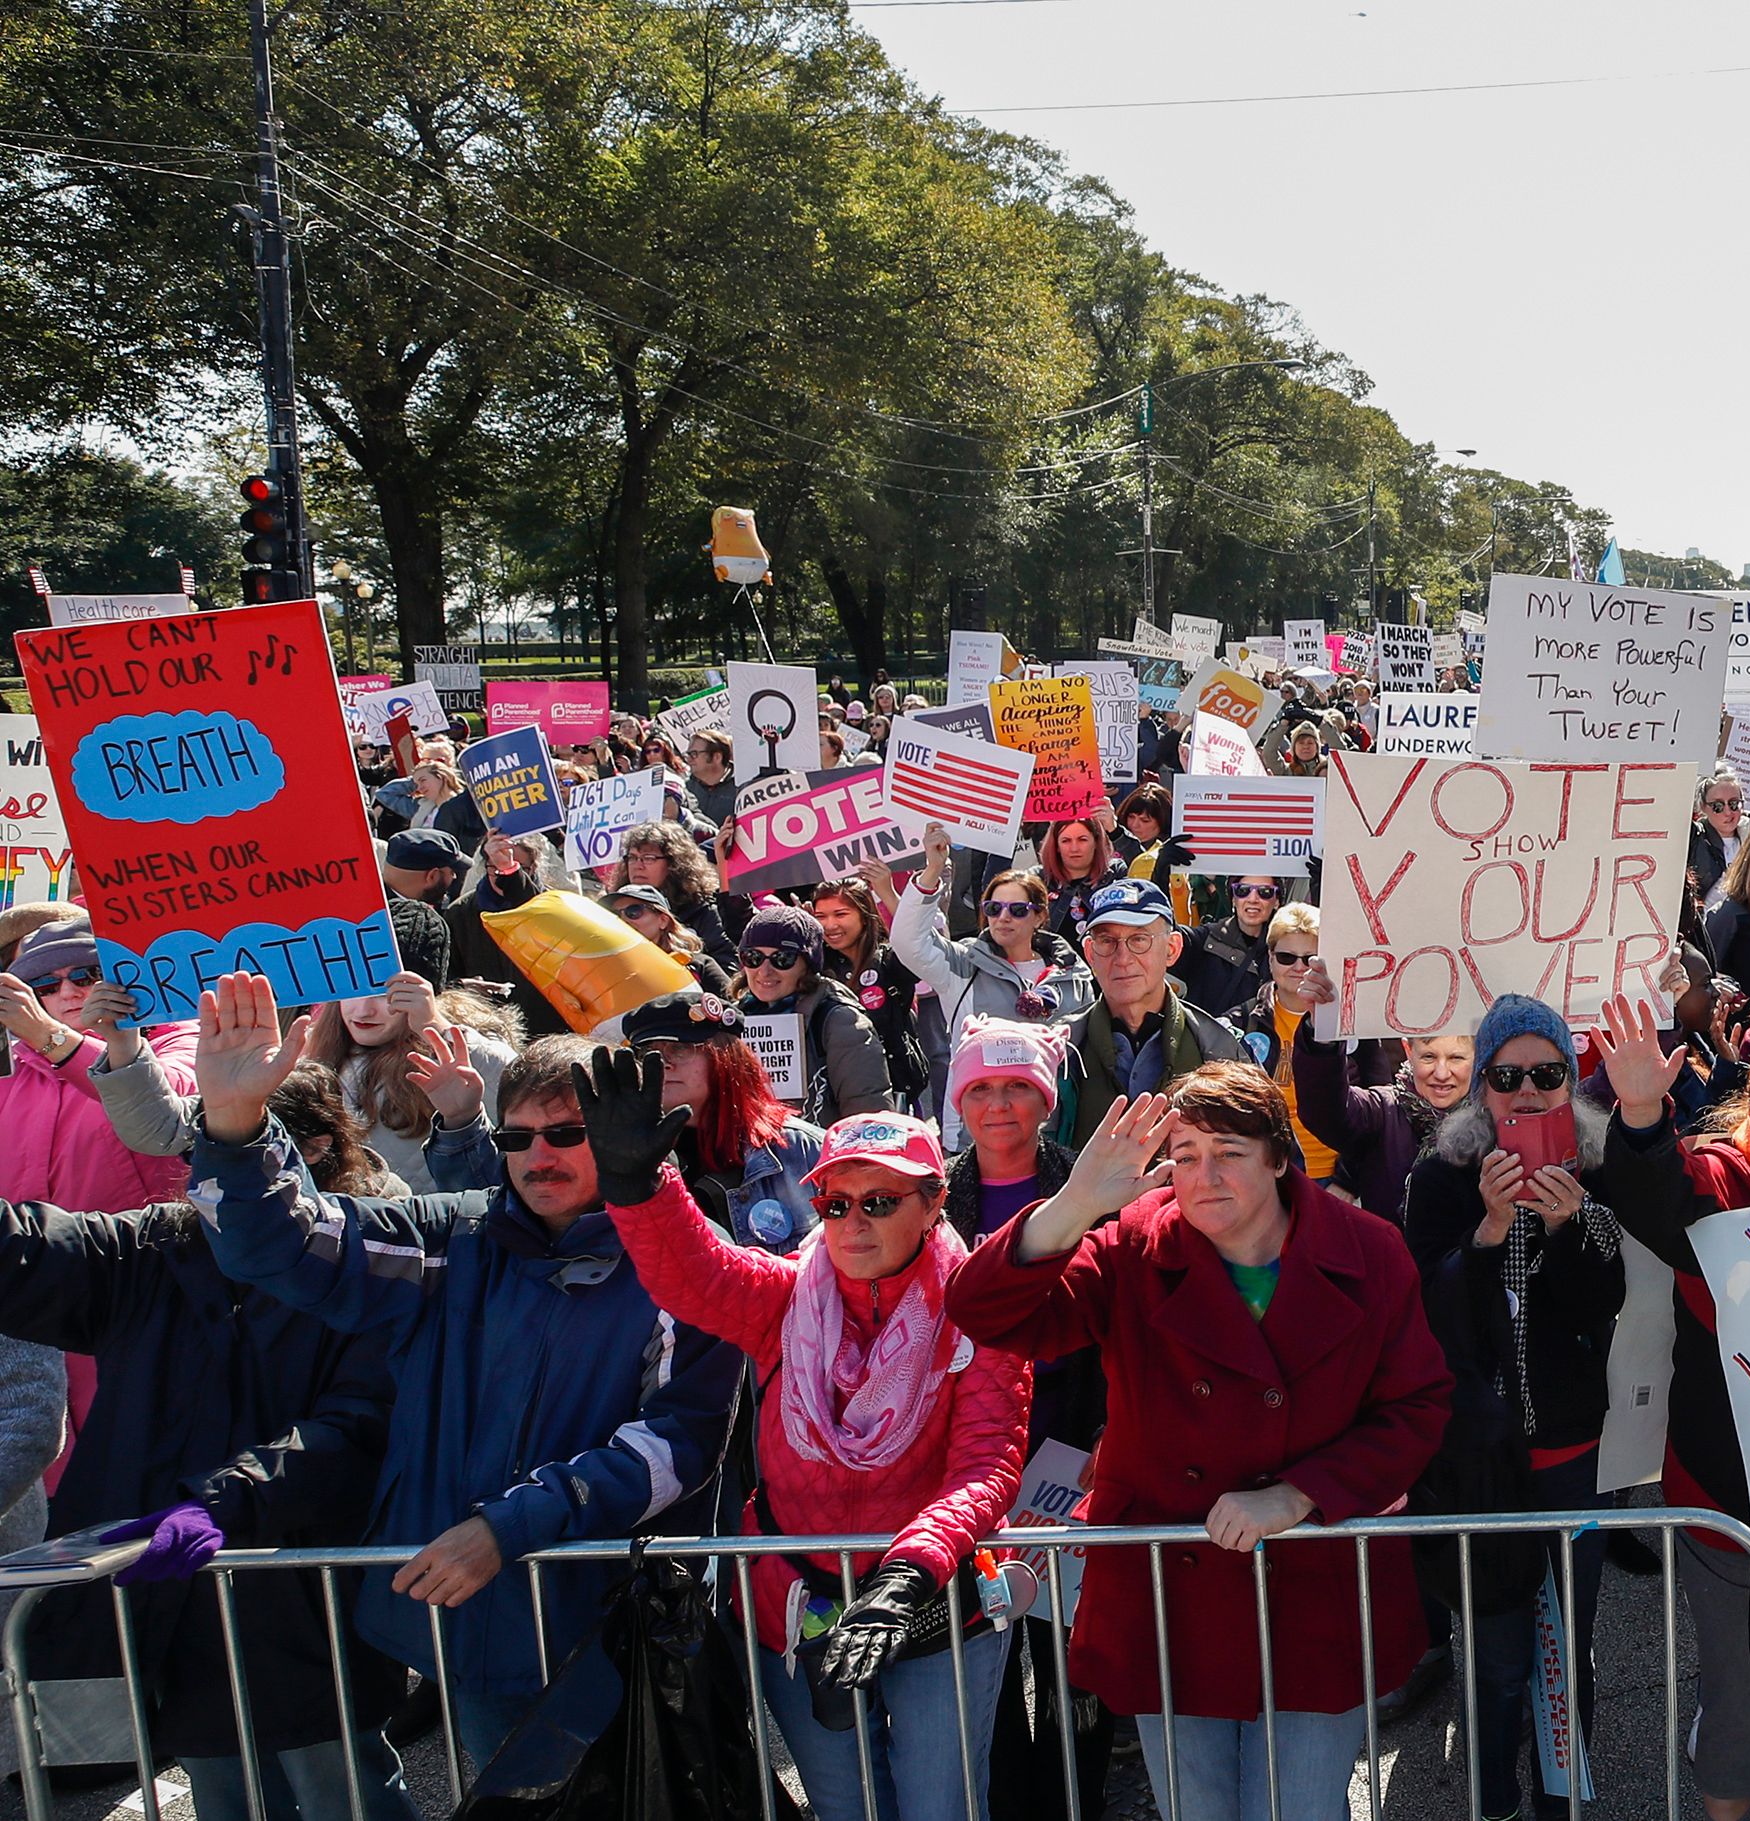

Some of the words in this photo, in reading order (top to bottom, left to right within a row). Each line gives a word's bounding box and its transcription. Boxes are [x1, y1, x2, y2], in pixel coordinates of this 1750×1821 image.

[1527, 592, 1572, 620] MY
[1589, 591, 1667, 626] VOTE
[1688, 606, 1716, 633] IS
[1173, 616, 1190, 633] We
[1191, 623, 1217, 637] march
[1346, 629, 1366, 643] 1920
[26, 630, 93, 667] WE
[127, 617, 218, 651] CAN'T
[1173, 638, 1189, 651] We
[1190, 640, 1209, 652] vote
[1292, 640, 1318, 650] WITH
[1342, 642, 1364, 655] 2018
[1534, 634, 1601, 661] MORE
[1154, 648, 1174, 658] Vote
[1296, 653, 1319, 662] HER
[1382, 644, 1401, 660] SO
[1402, 645, 1433, 662] THEY
[44, 660, 150, 708] HOLD
[159, 653, 223, 688] OUR
[424, 666, 475, 687] OUTTA
[997, 683, 1006, 697] I
[1019, 681, 1044, 694] AM
[1060, 676, 1085, 689] NO
[1011, 691, 1074, 707] LONGER
[1527, 673, 1594, 701] Than
[1612, 677, 1668, 709] Your
[564, 708, 604, 716] Parenthood
[1107, 699, 1138, 725] THE
[1146, 694, 1177, 710] 2018
[1200, 681, 1259, 727] fool
[946, 720, 962, 732] WE
[962, 717, 981, 728] ALL
[1000, 724, 1024, 735] THE
[1037, 715, 1080, 729] THINGS
[1032, 725, 1082, 739] CANNOT
[1548, 708, 1681, 746] TWEET!
[101, 723, 259, 800] BREATH
[895, 740, 933, 767] VOTE
[1046, 752, 1071, 763] AM
[1740, 758, 1750, 766] we
[474, 763, 492, 782] AM
[495, 753, 521, 773] AN
[570, 781, 604, 811] 1764
[613, 777, 642, 806] Days
[1330, 749, 1677, 842] VOTE
[614, 811, 635, 825] can
[964, 818, 986, 832] ACLU
[823, 826, 920, 872] WIN.
[1462, 832, 1562, 862] SHOW
[86, 850, 197, 892] WHEN
[209, 839, 269, 871] OUR
[104, 876, 239, 926] SISTERS
[247, 857, 360, 898] CANNOT
[112, 925, 390, 1022] BREATHE
[758, 1039, 794, 1053] VOTER
